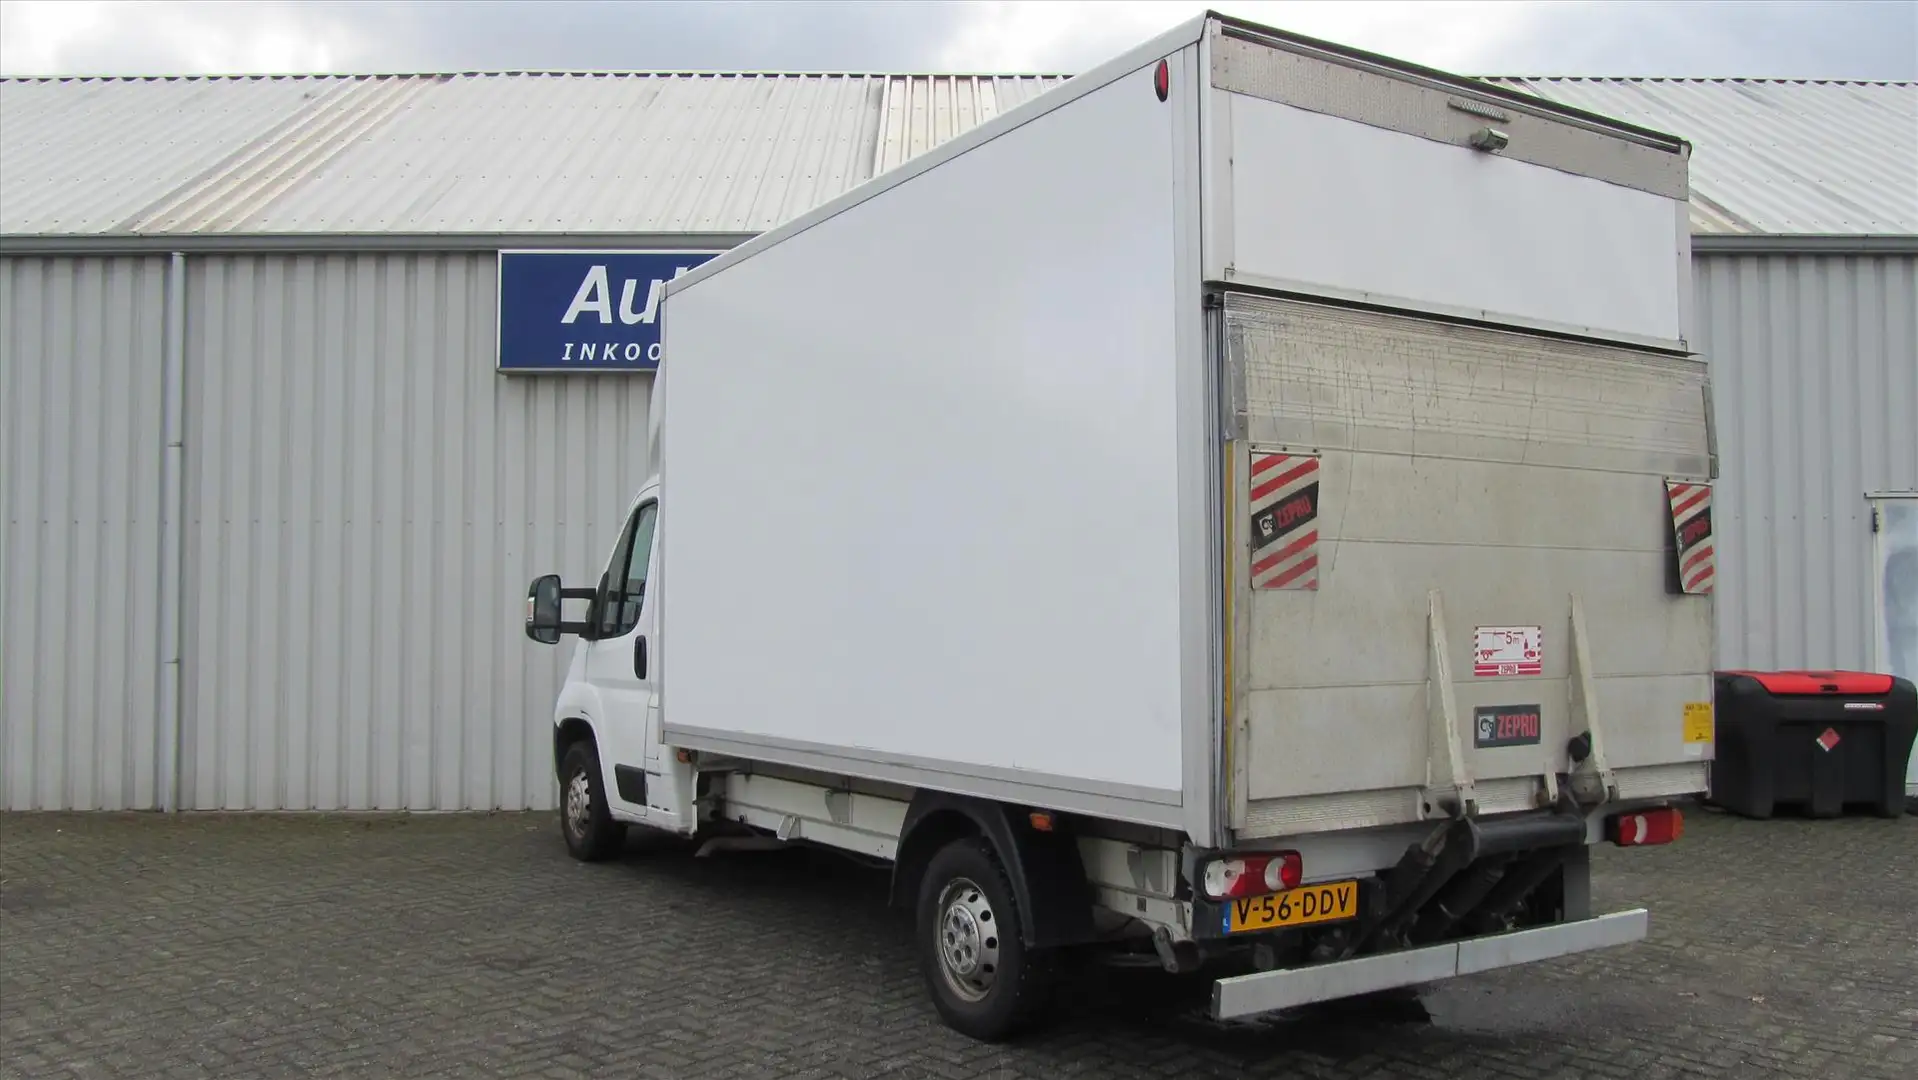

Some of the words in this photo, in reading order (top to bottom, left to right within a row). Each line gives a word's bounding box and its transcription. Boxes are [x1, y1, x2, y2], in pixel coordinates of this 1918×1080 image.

[560, 265, 688, 325] Au
[1273, 495, 1312, 529] ZEPRO
[1497, 713, 1538, 739] ZEPRO
[1237, 887, 1351, 926] V-56-DDV
